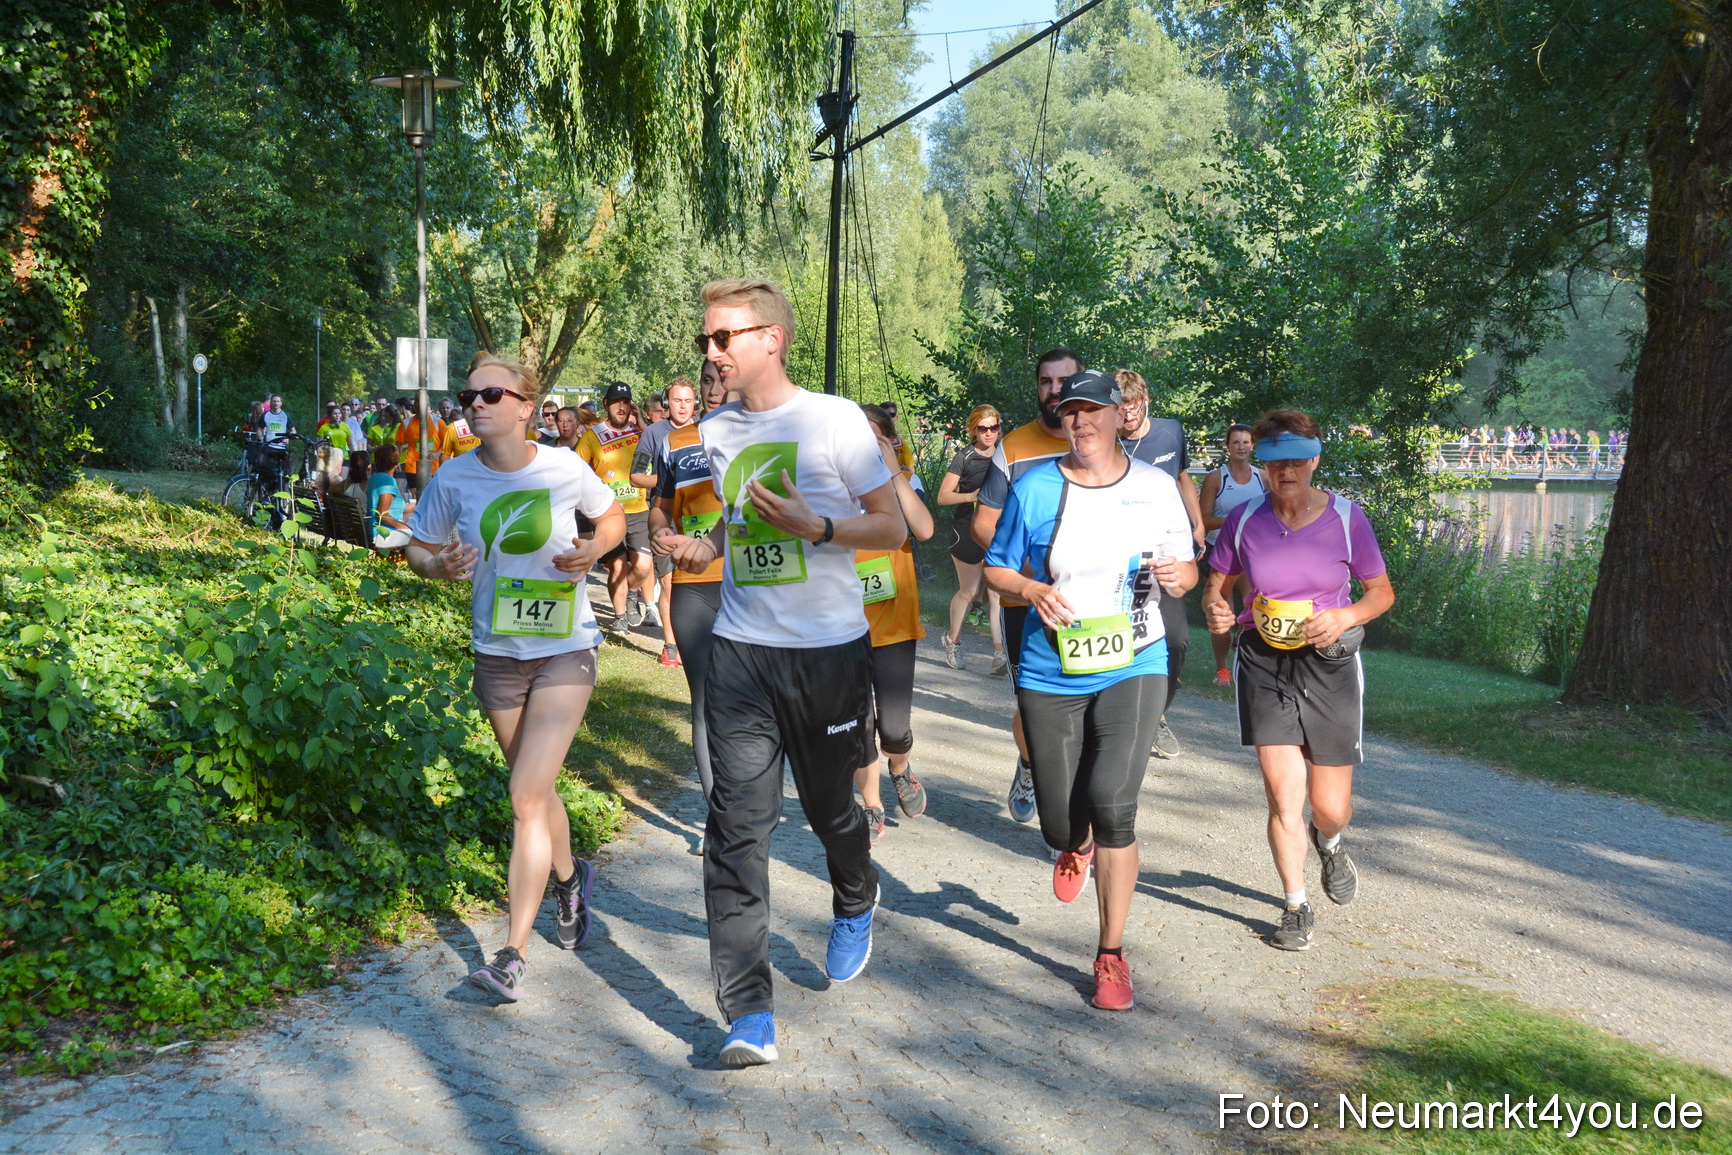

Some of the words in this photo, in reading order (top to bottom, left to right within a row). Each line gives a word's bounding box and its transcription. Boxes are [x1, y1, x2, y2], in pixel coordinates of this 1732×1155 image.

[603, 443, 624, 454] MAX
[614, 486, 636, 497] 1246
[744, 544, 784, 568] 183
[513, 599, 557, 621] 147
[1262, 614, 1296, 636] 297
[1068, 634, 1124, 659] 2120
[828, 719, 858, 735] Kempa
